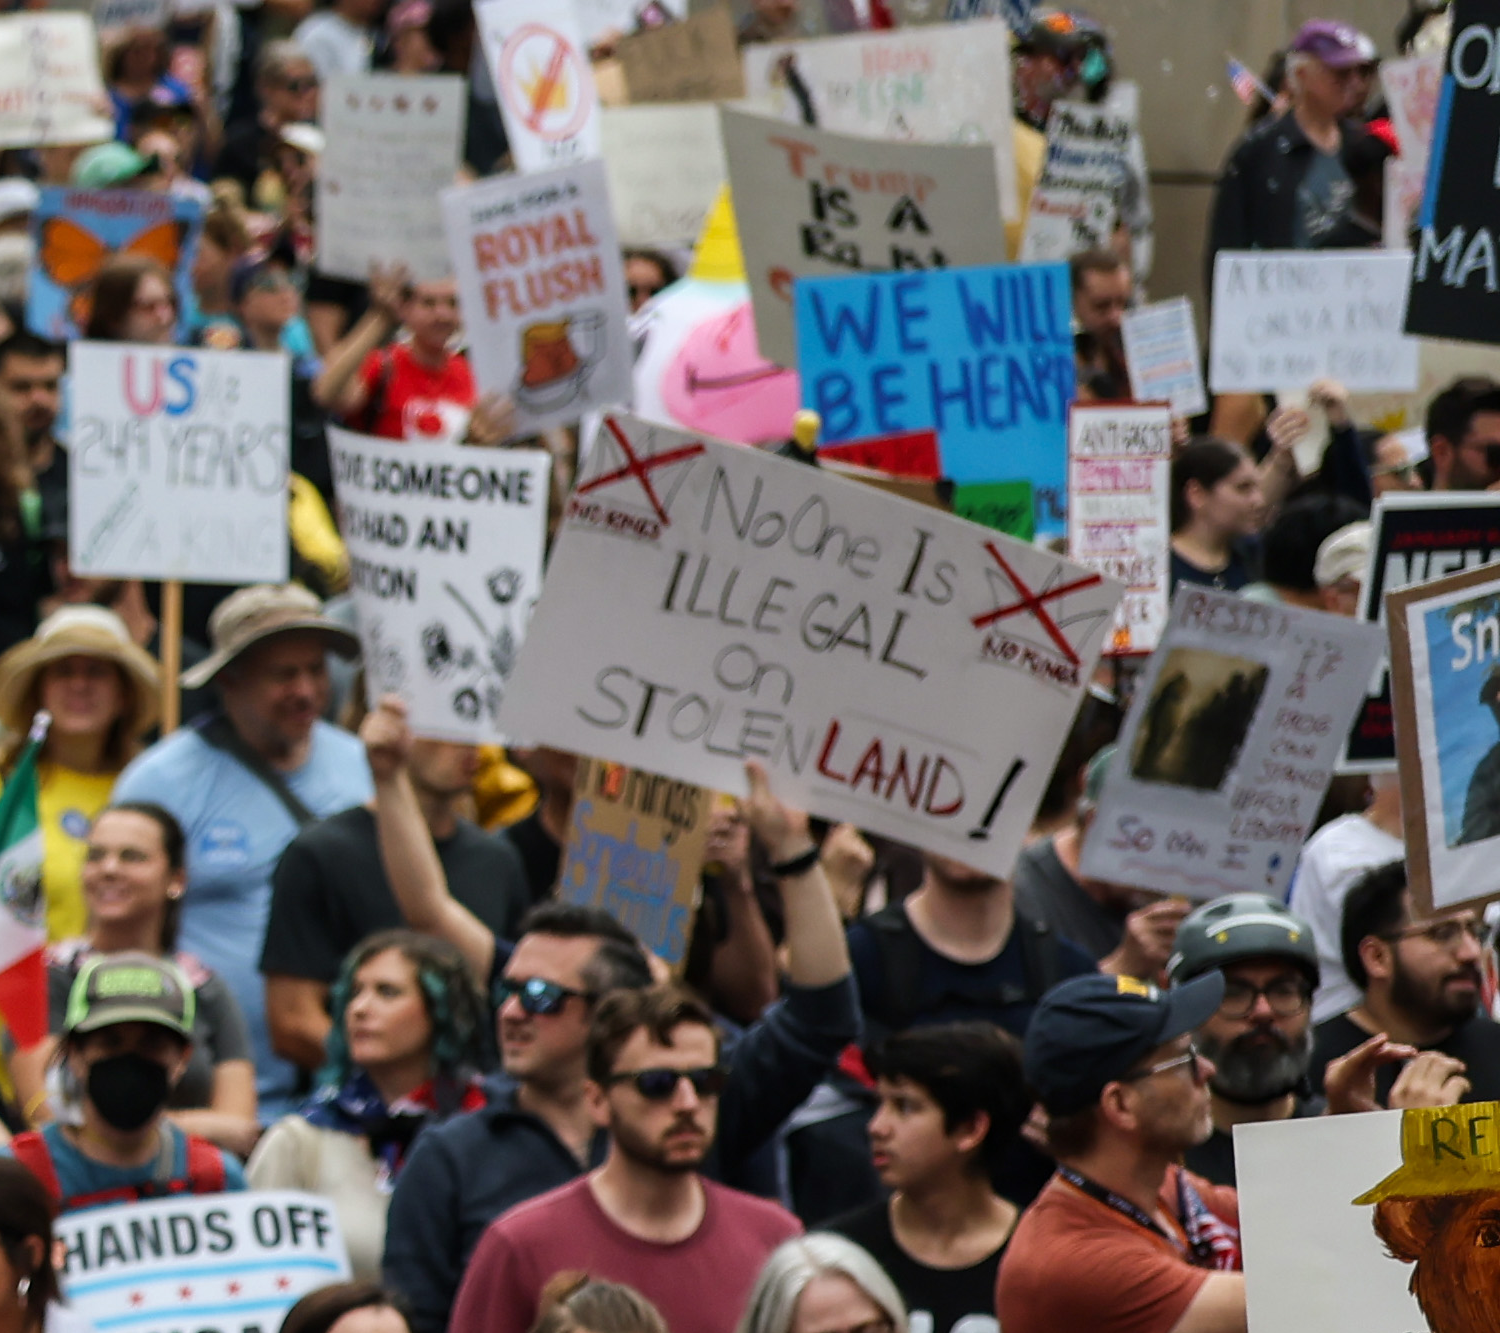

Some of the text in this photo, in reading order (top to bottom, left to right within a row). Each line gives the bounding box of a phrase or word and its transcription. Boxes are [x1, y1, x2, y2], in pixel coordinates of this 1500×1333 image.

[473, 208, 598, 273] ROYAL
[481, 254, 606, 322] FLUSH
[810, 264, 1072, 355] WE WILL
[122, 354, 198, 417] US
[816, 350, 1077, 438] BE HEARD
[371, 457, 534, 508] SOMEONE
[415, 517, 470, 554] AN
[900, 527, 958, 606] Is
[660, 551, 928, 681] ILLEGAL
[575, 664, 816, 775] STOLEN
[56, 1202, 334, 1272] HANDS OFF
